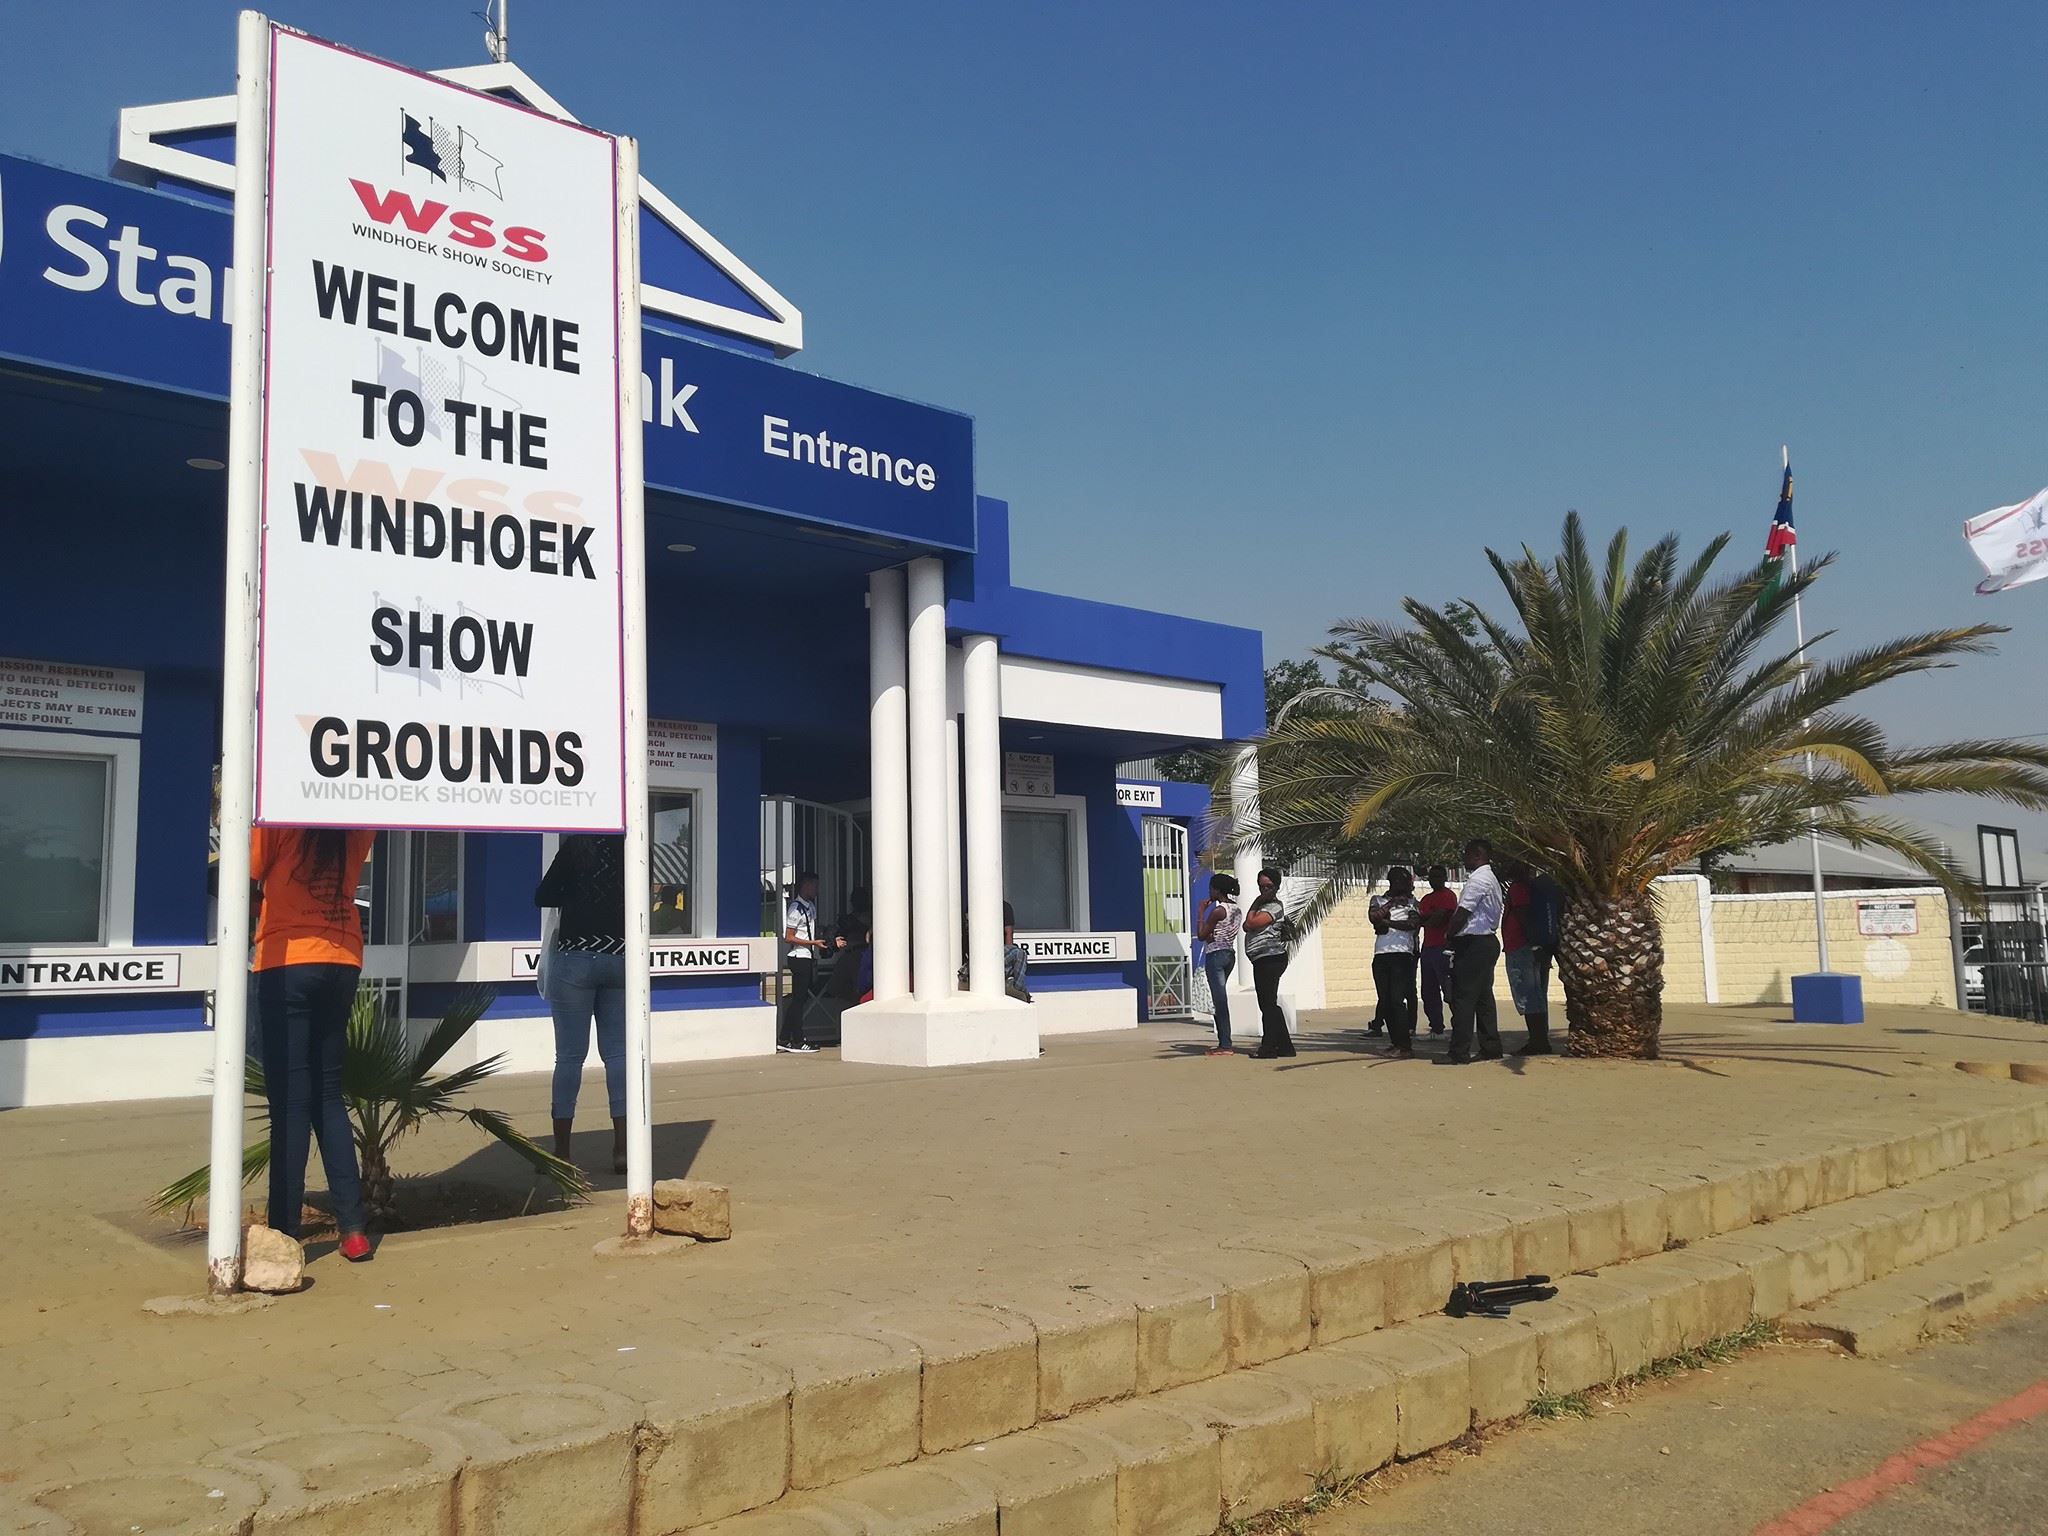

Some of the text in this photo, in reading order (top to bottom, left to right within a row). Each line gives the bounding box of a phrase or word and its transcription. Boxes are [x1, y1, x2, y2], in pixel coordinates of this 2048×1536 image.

[348, 177, 549, 263] WSS
[43, 204, 234, 325] Sta
[351, 222, 553, 286] WINDHOEK SHOW SOCIETY
[312, 258, 581, 375] WELCOME
[351, 379, 548, 471] TO THE
[763, 414, 936, 492] Entrance
[293, 481, 597, 581] WINDHOEK
[369, 606, 534, 678] SHOW
[48, 664, 115, 679] RESERVED
[6, 686, 59, 699] SEARCH
[20, 675, 63, 687] METAL
[67, 679, 136, 693] DETECTION
[0, 699, 137, 718] JECTS MAY BE TAKEN
[32, 713, 73, 725] POINT.
[669, 733, 712, 742] DETECTION
[309, 716, 584, 788] GROUNDS
[657, 750, 675, 758] MAY
[689, 752, 713, 761] TAKEN
[649, 759, 675, 768] POINT.
[300, 780, 598, 808] WINDHOEK SHOW SOCIETY
[1134, 790, 1155, 802] EXIT
[650, 950, 740, 967] TRANCE
[1034, 941, 1110, 956] ENTRANCE
[1, 961, 164, 984] NTRANCE
